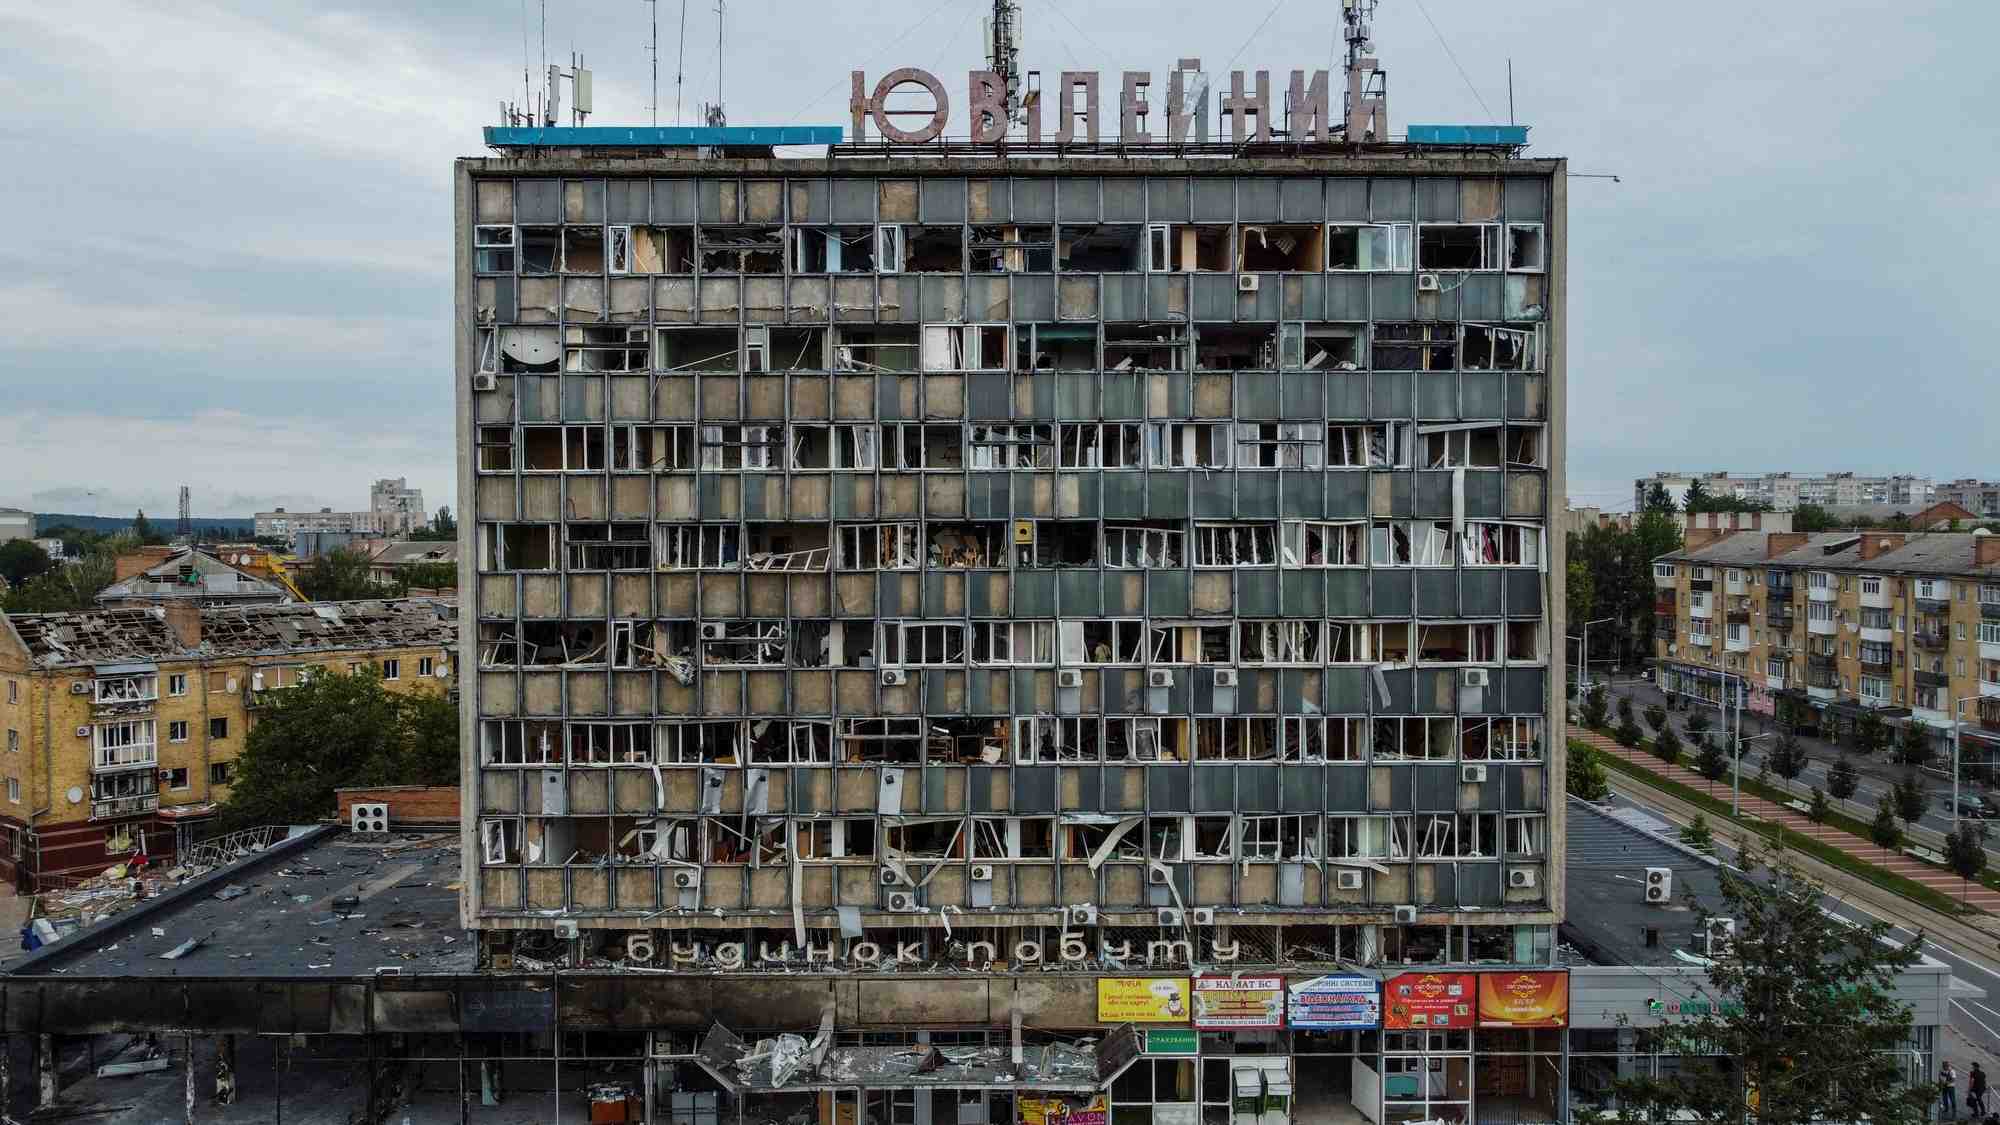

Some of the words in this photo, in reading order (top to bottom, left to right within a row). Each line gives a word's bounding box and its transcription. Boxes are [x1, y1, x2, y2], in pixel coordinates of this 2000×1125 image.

[850, 58, 1387, 144] ЮВІЛЕЙНИЙ
[627, 933, 923, 969] будинок
[967, 931, 1240, 961] побуту
[1068, 1113, 1105, 1121] AVON
